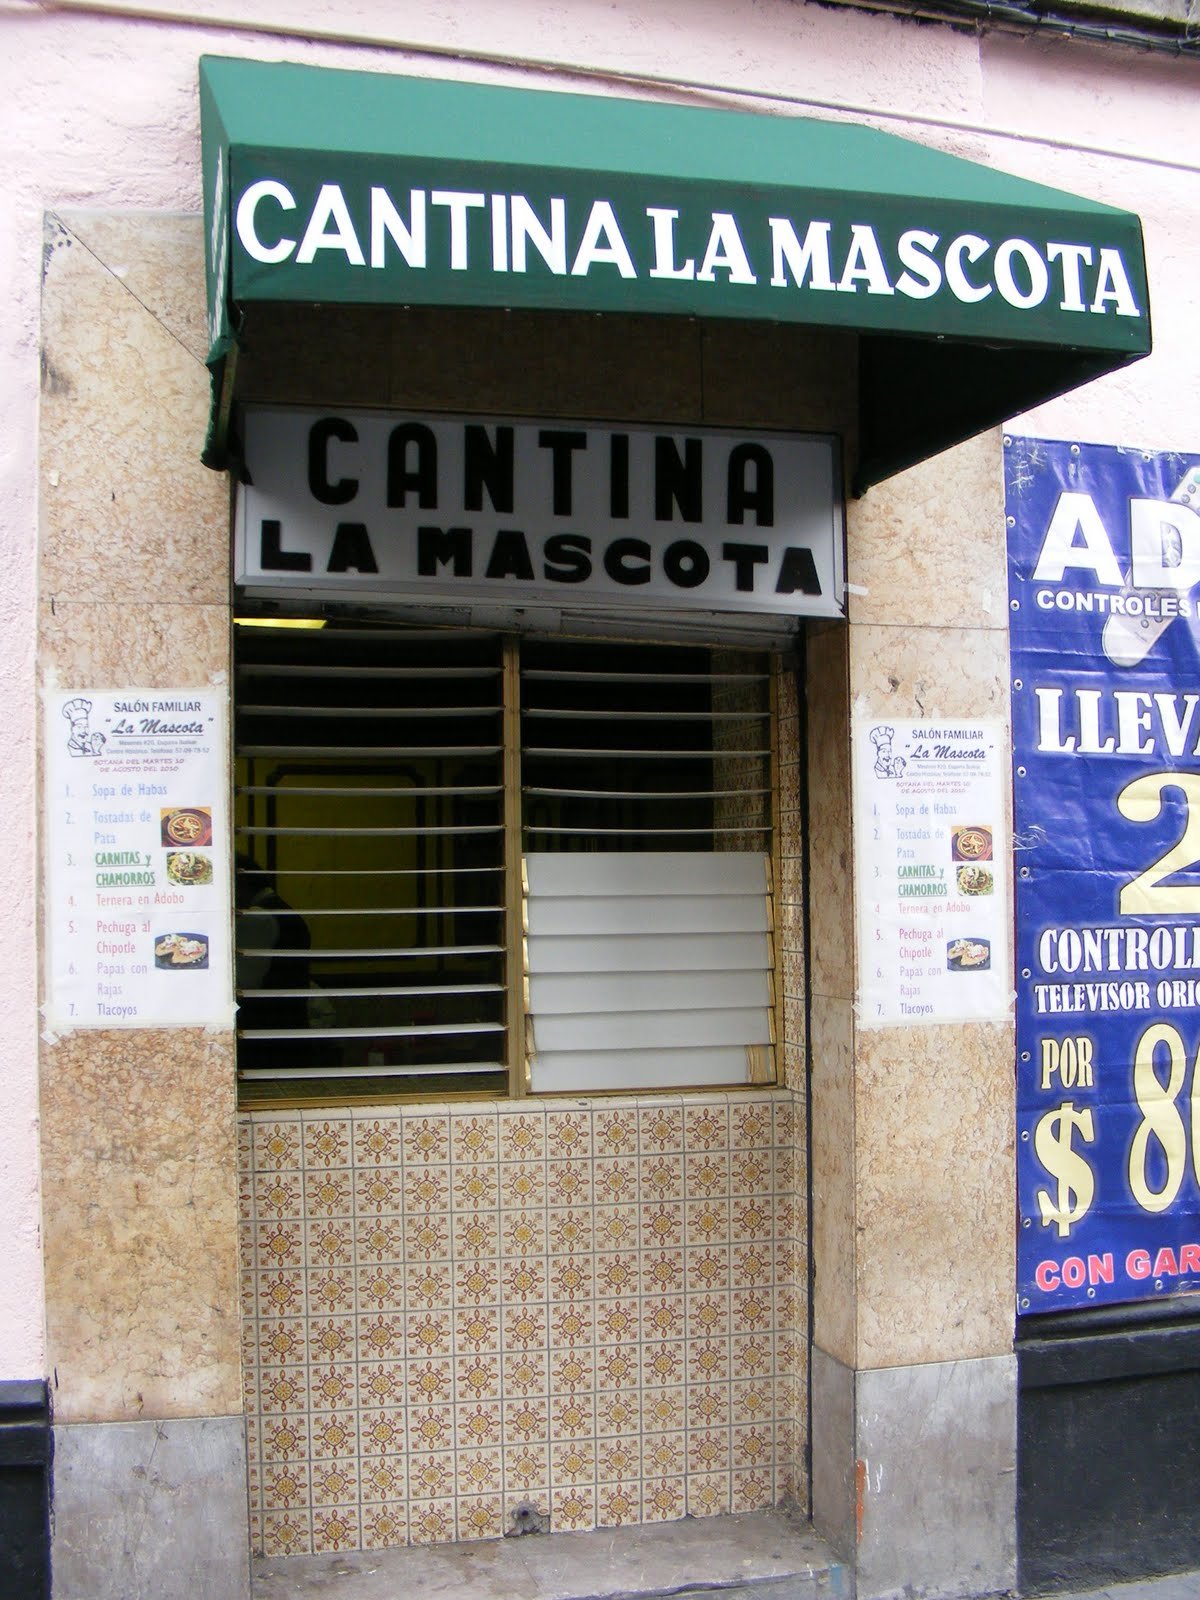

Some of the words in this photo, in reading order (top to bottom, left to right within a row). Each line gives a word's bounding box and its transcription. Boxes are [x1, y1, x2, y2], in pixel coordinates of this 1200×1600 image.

[236, 180, 637, 278] CANTINA
[646, 208, 756, 285] LA
[769, 217, 1140, 317] MASCOTA
[308, 417, 773, 527] CANTINA
[261, 520, 378, 573] LA
[417, 527, 822, 595] MASCOTA
[1036, 590, 1192, 618] CONTROLES
[114, 699, 150, 712] SALÓN
[152, 701, 201, 712] FAMILIAR
[140, 718, 204, 734] Mascota
[1035, 688, 1200, 756] LLEV
[912, 728, 941, 739] SALÓN
[944, 730, 983, 740] FAMILIAR
[934, 745, 986, 759] Mascota
[92, 784, 116, 799] Sopa
[121, 784, 133, 796] de
[138, 783, 168, 796] Habas
[93, 811, 134, 824] Tostadas
[139, 811, 152, 823] de
[895, 804, 915, 817] Sopa
[919, 804, 929, 815] de
[933, 804, 957, 815] Habas
[94, 832, 116, 844] Pata
[897, 829, 931, 840] Tostadas
[935, 829, 944, 839] de
[1117, 772, 1200, 915] 2
[95, 852, 140, 865] CARNITAS
[145, 855, 152, 868] y
[897, 848, 915, 858] Pata
[96, 872, 156, 886] CHAMORROS
[897, 865, 936, 877] CARNITAS
[939, 868, 944, 879] y
[898, 884, 947, 896] CHAMORROS
[96, 893, 133, 906] Ternera
[138, 896, 149, 905] en
[154, 893, 184, 905] Adobo
[899, 903, 929, 913] Ternera
[933, 905, 943, 913] en
[946, 902, 971, 913] Adobo
[96, 920, 136, 936] Pechuga
[142, 920, 150, 932] al
[899, 929, 932, 942] Pechuga
[937, 928, 944, 938] al
[96, 941, 136, 957] Chipotle
[899, 947, 932, 960] Chipotle
[96, 962, 125, 978] Papas
[131, 965, 148, 975] con
[900, 967, 923, 980] Papas
[928, 967, 942, 975] con
[97, 983, 123, 998] Rajas
[900, 986, 920, 998] Rajas
[1035, 981, 1150, 1014] TELEVISOR
[97, 1003, 137, 1019] Tlacoyos
[901, 1003, 934, 1016] Tlacoyos
[1041, 1037, 1094, 1090] POR
[1128, 1023, 1200, 1213] 8
[1035, 1253, 1114, 1291] CON
[1126, 1244, 1200, 1279] GAR
